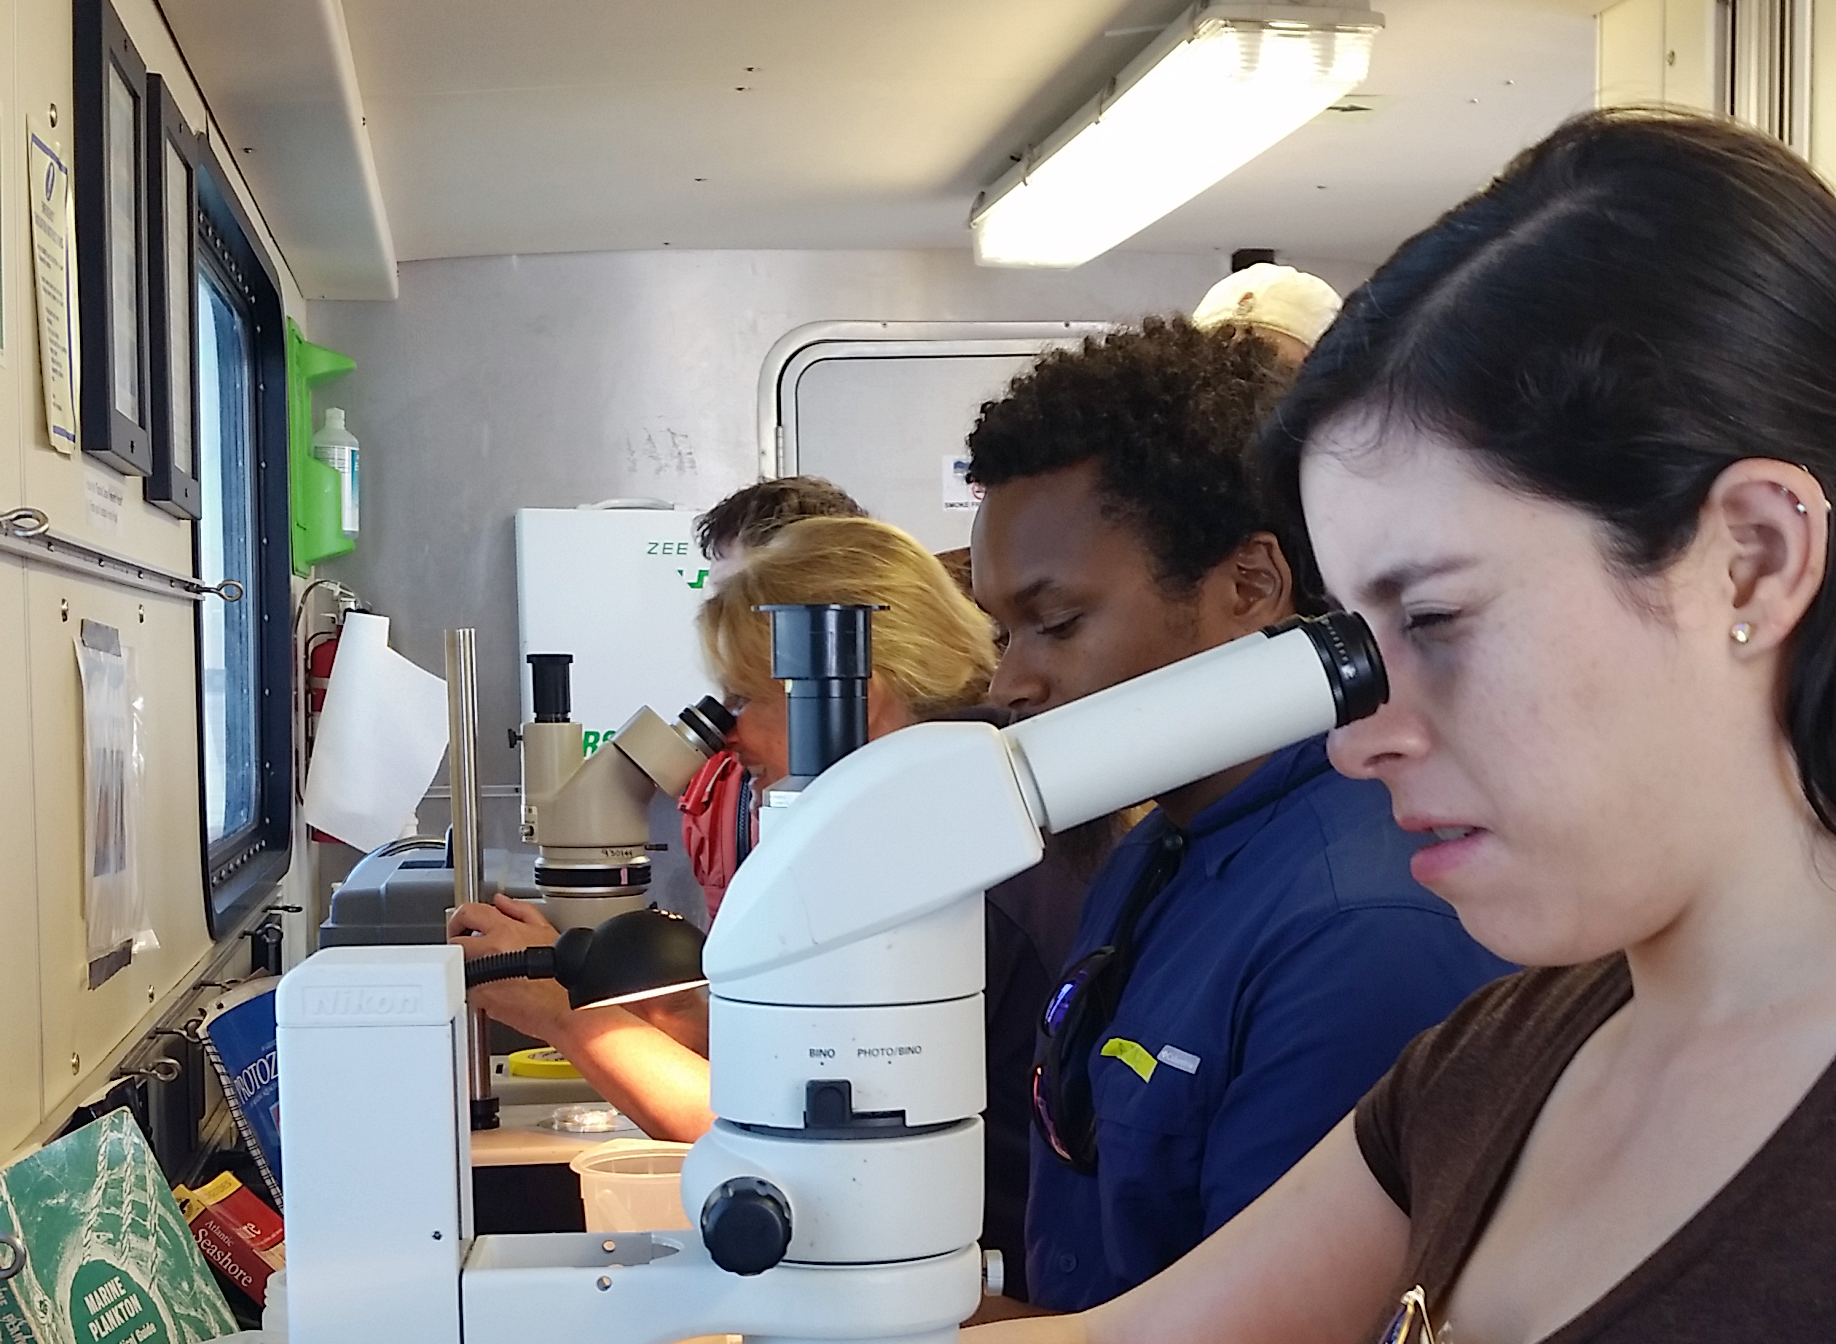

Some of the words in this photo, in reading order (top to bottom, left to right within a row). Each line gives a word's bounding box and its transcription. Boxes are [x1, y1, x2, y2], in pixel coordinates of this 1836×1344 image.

[944, 501, 969, 509] SMOKE
[646, 541, 689, 555] ZEE
[310, 989, 418, 1015] Nikon
[809, 1048, 836, 1059] BINO
[857, 1045, 922, 1058] PHOTO/BINO
[234, 1051, 279, 1104] PROTOZ
[205, 1220, 234, 1247] Atlantic
[193, 1227, 253, 1287] Seashore
[84, 1276, 126, 1316] MARINE
[88, 1293, 143, 1342] PLANKTON
[135, 1322, 157, 1342] Guide
